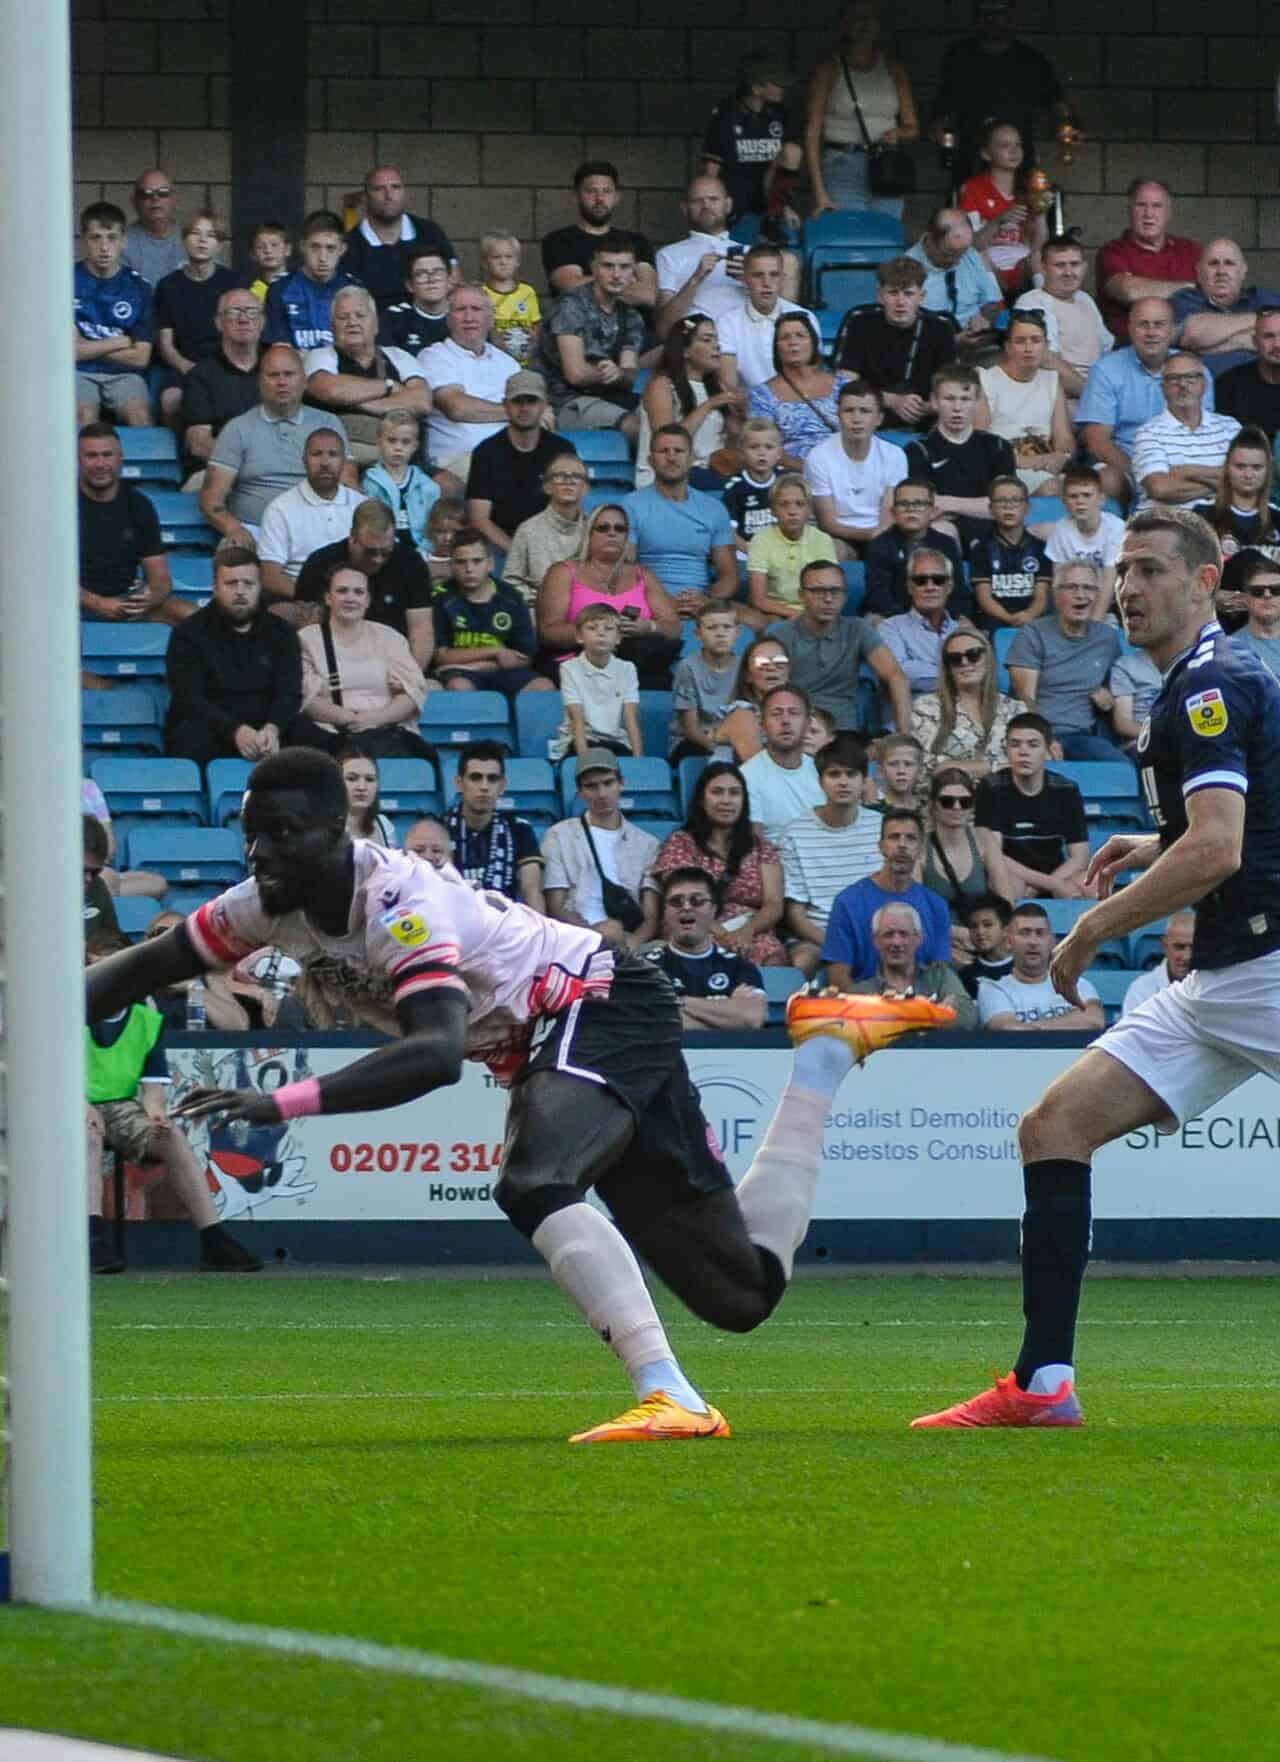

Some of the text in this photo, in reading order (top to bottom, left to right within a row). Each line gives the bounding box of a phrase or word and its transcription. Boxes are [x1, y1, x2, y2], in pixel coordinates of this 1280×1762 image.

[824, 1107, 1019, 1128] ecialist Demolitio
[1126, 1117, 1280, 1149] SPECIA
[330, 1143, 440, 1172] 02072
[429, 1183, 496, 1201] Howd
